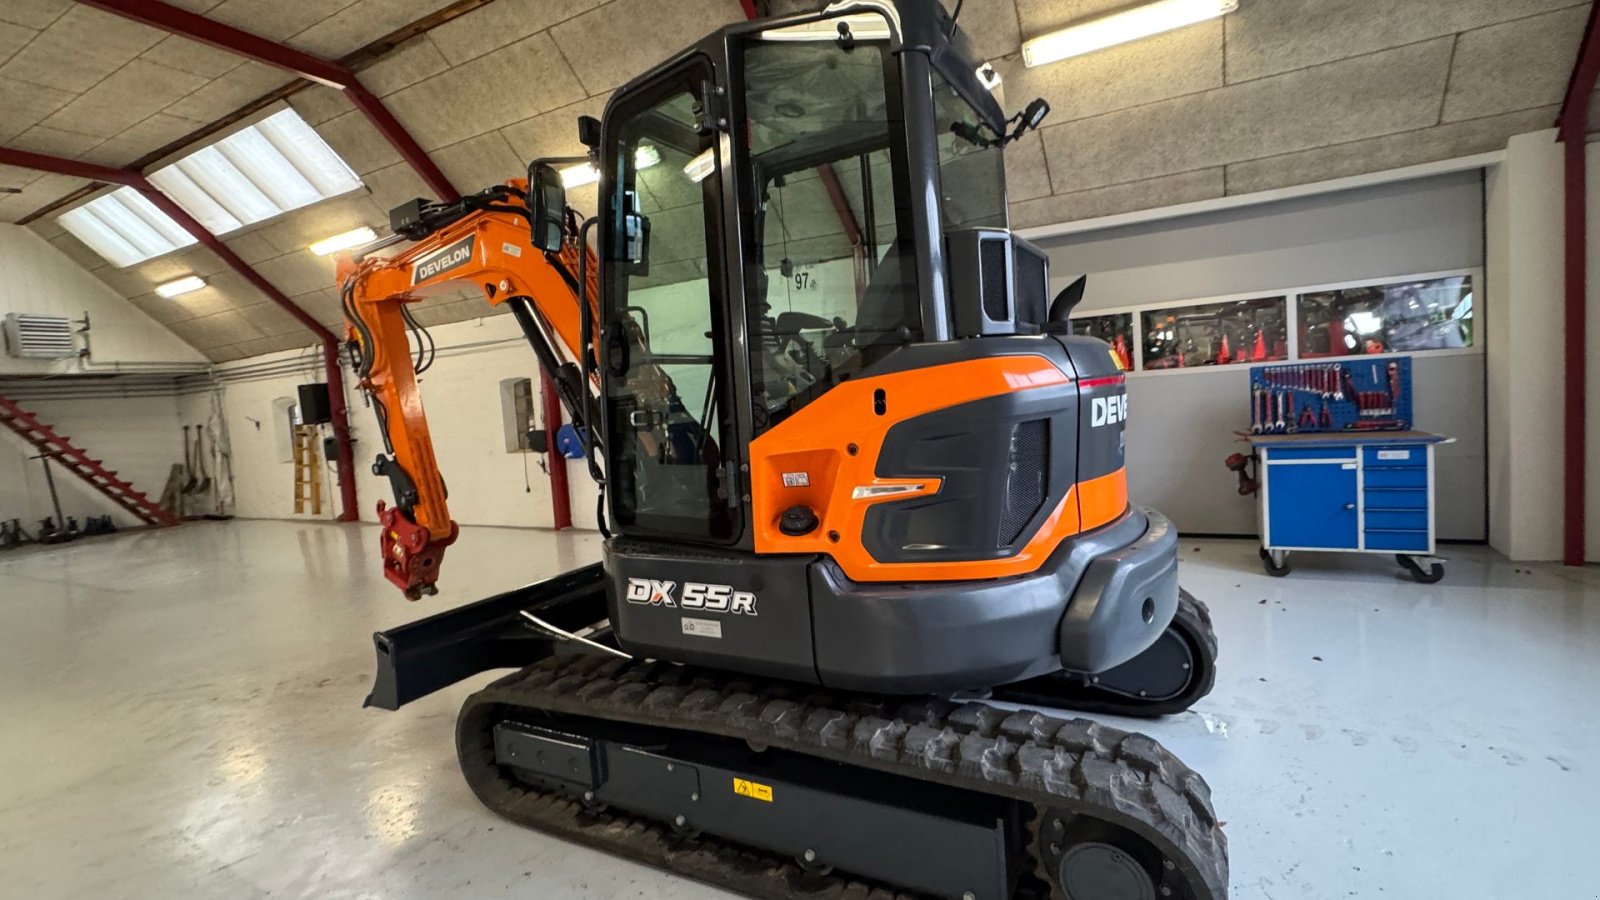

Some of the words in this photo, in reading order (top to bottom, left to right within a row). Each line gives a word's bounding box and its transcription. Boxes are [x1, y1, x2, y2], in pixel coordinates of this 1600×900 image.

[419, 245, 471, 279] DEVELON
[795, 272, 809, 290] 97
[627, 577, 677, 608] DX
